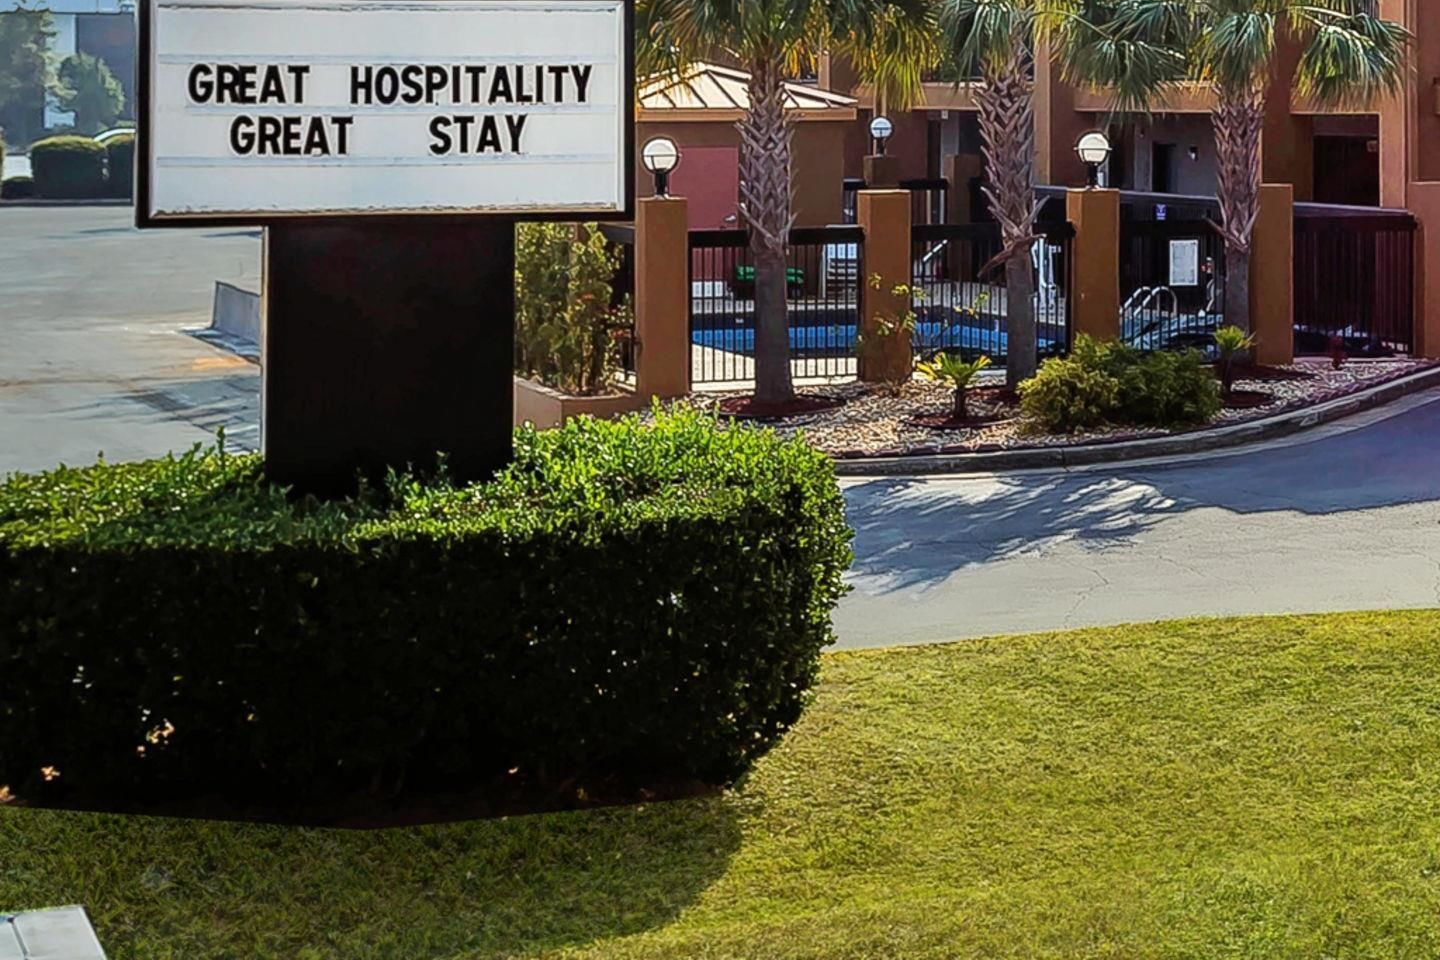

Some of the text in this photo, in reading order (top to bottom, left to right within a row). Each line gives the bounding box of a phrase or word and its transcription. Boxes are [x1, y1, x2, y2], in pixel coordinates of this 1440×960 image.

[188, 65, 592, 104] GREAT HOSPITALITY
[230, 114, 527, 155] GREAT STAY
